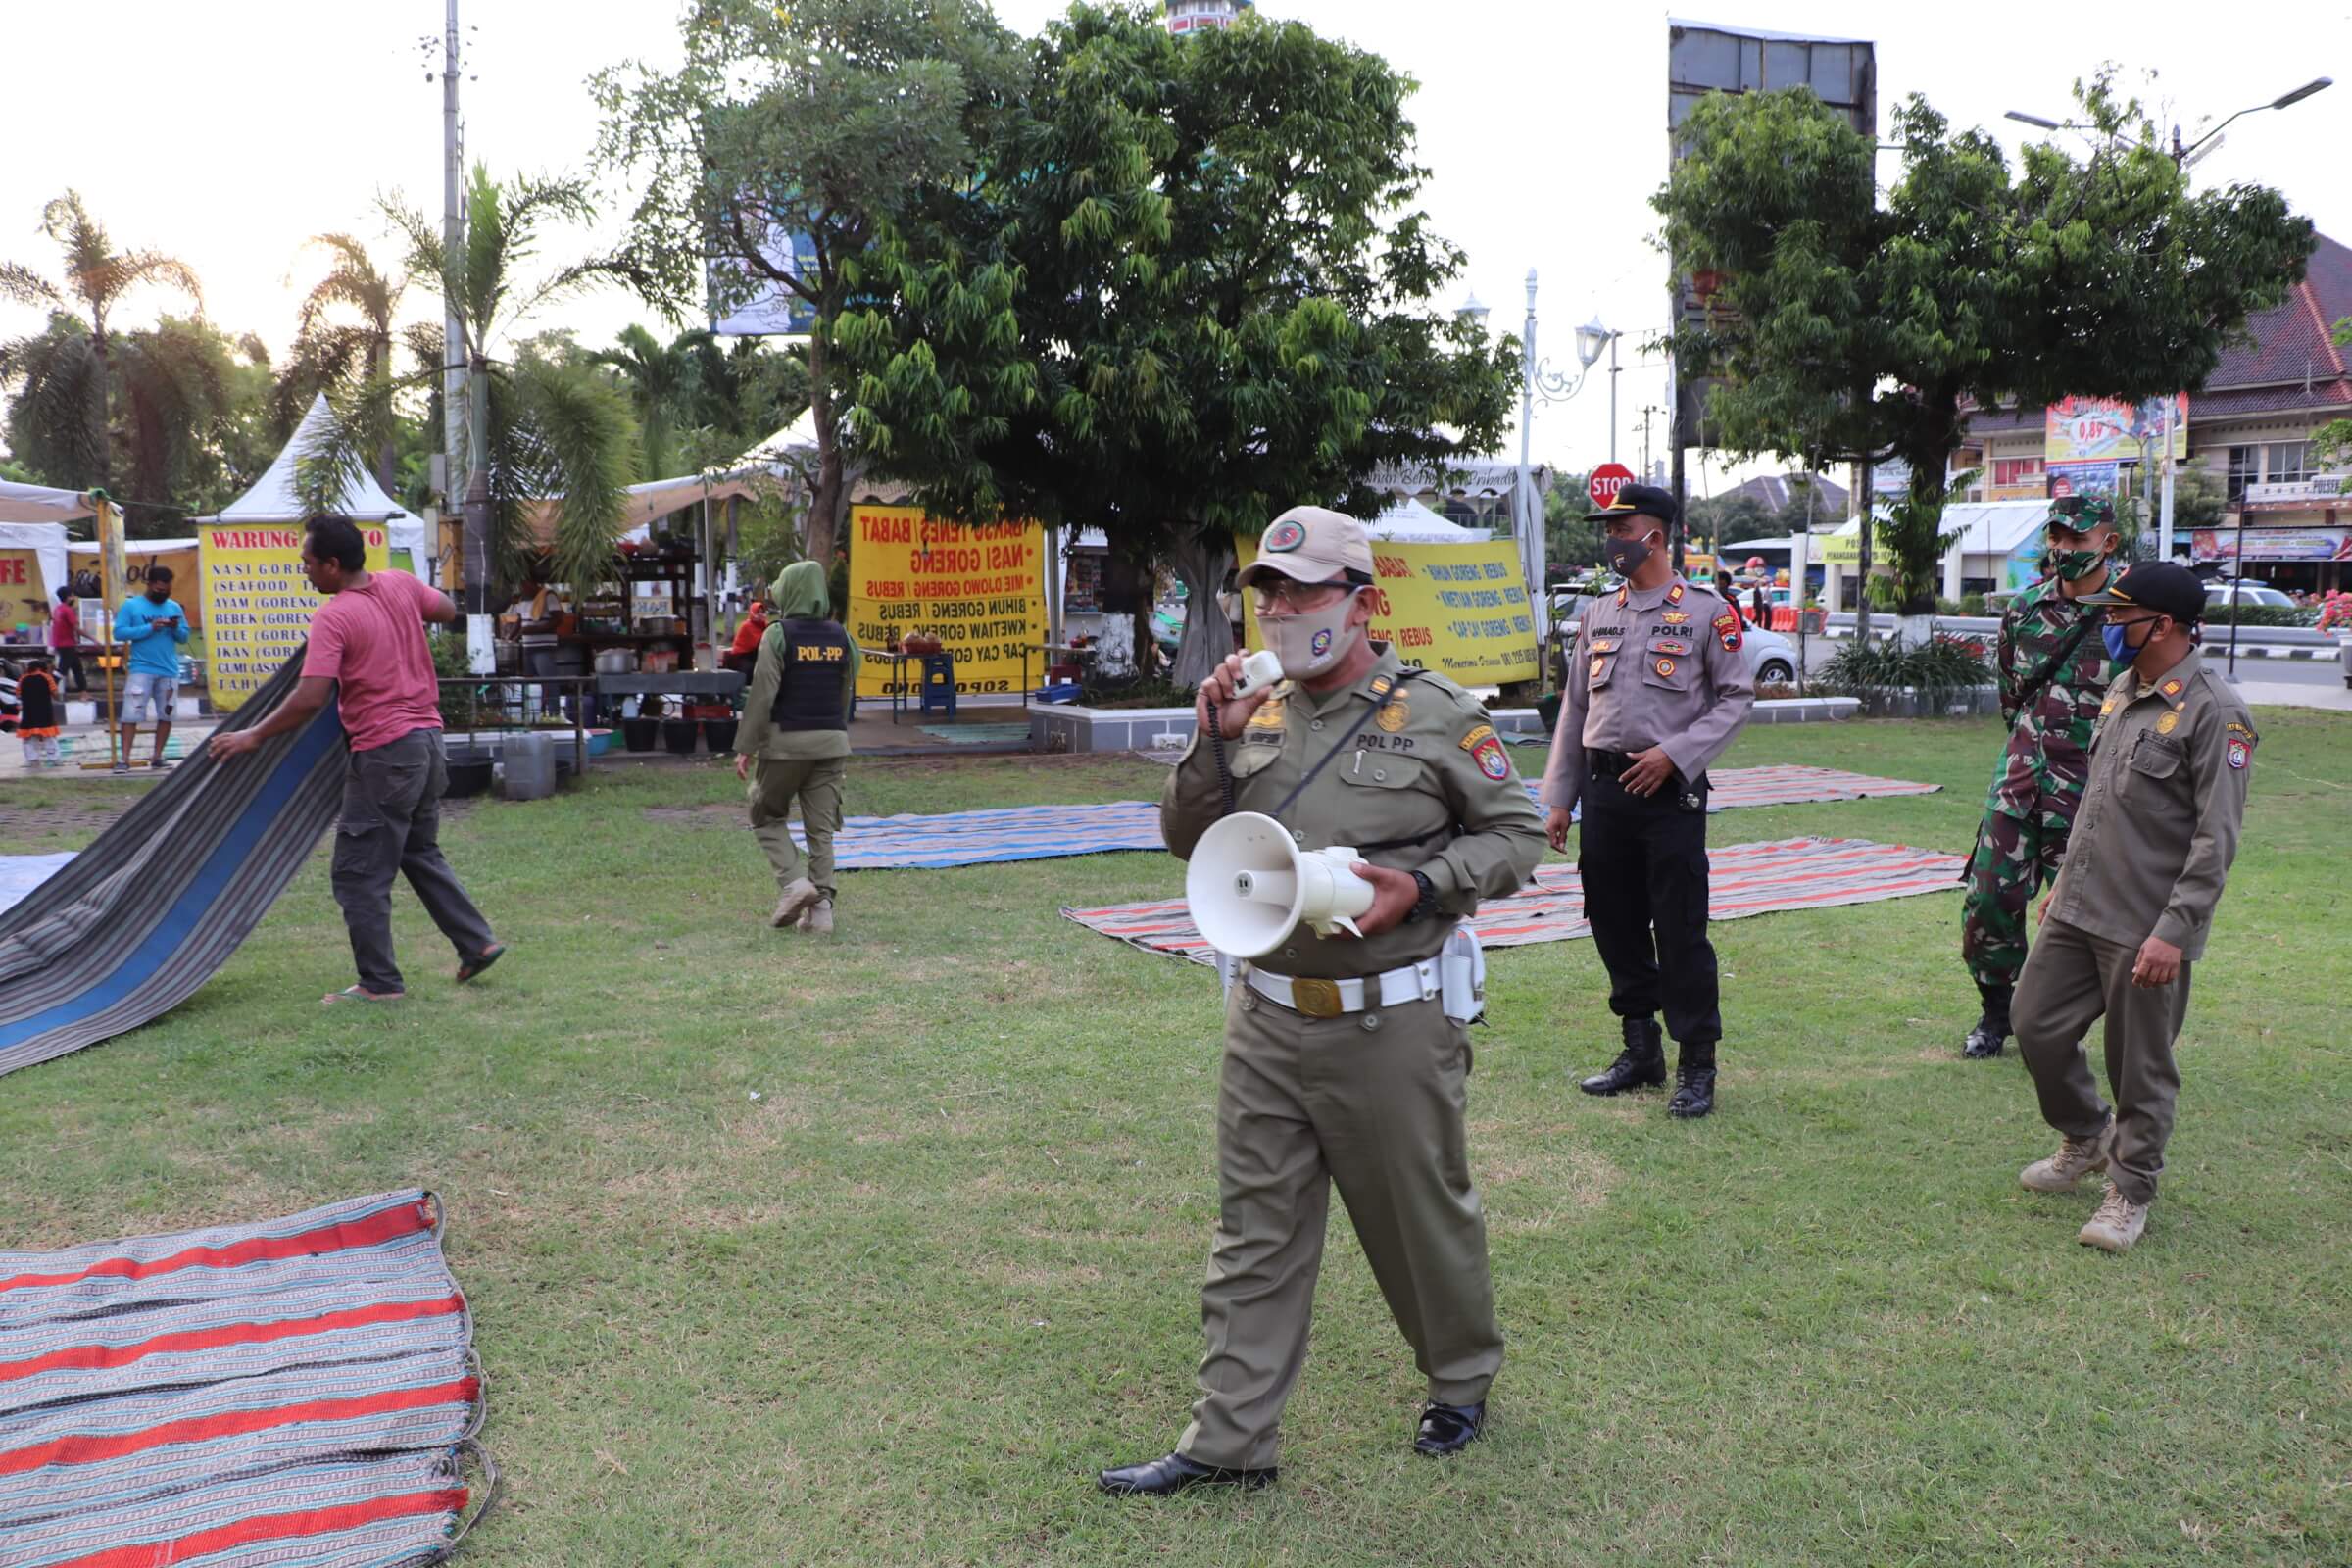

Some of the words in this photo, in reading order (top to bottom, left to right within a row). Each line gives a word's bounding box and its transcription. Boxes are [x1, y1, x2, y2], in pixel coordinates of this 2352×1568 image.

[212, 530, 298, 549] WARUNG
[212, 564, 251, 575] NASI
[259, 564, 306, 575] GORE
[214, 597, 249, 609] AYAM
[216, 613, 257, 625] BEBEK
[262, 613, 312, 625] (GOREN
[216, 630, 247, 641] LELE
[255, 630, 309, 642] (GOREN
[1399, 626, 1433, 648] REBUS
[1651, 626, 1693, 637] POLRI
[217, 647, 250, 658] IKAN
[797, 645, 843, 662] POL-PP
[218, 662, 247, 674] CUMI
[1356, 734, 1388, 749] POL
[1391, 736, 1415, 751] PP
